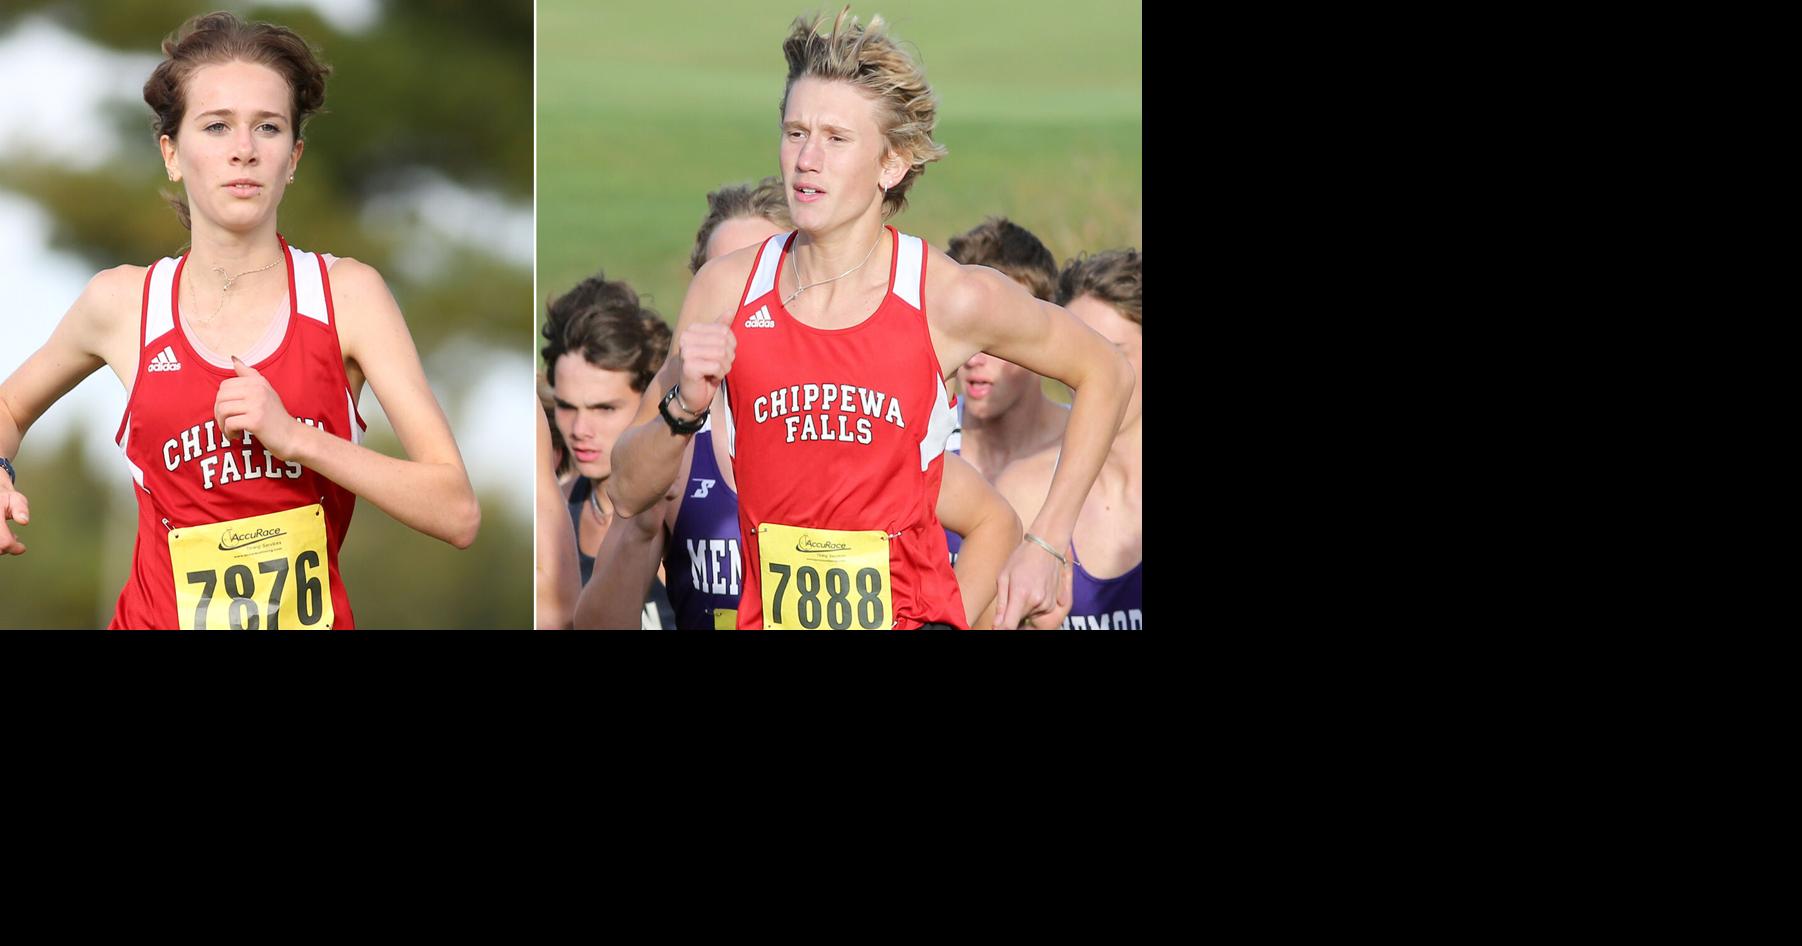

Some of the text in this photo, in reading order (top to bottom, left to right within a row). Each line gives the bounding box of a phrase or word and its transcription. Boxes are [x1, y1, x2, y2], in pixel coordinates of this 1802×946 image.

[744, 319, 775, 328] adidas
[148, 361, 181, 372] adidas
[753, 383, 906, 429] CHIPPEWA
[785, 414, 873, 445] FALLS
[200, 449, 303, 490] FALLS
[230, 527, 281, 542] AccuRace
[805, 539, 846, 549] AccuRace
[186, 550, 323, 630] 7876
[768, 562, 885, 630] 7888
